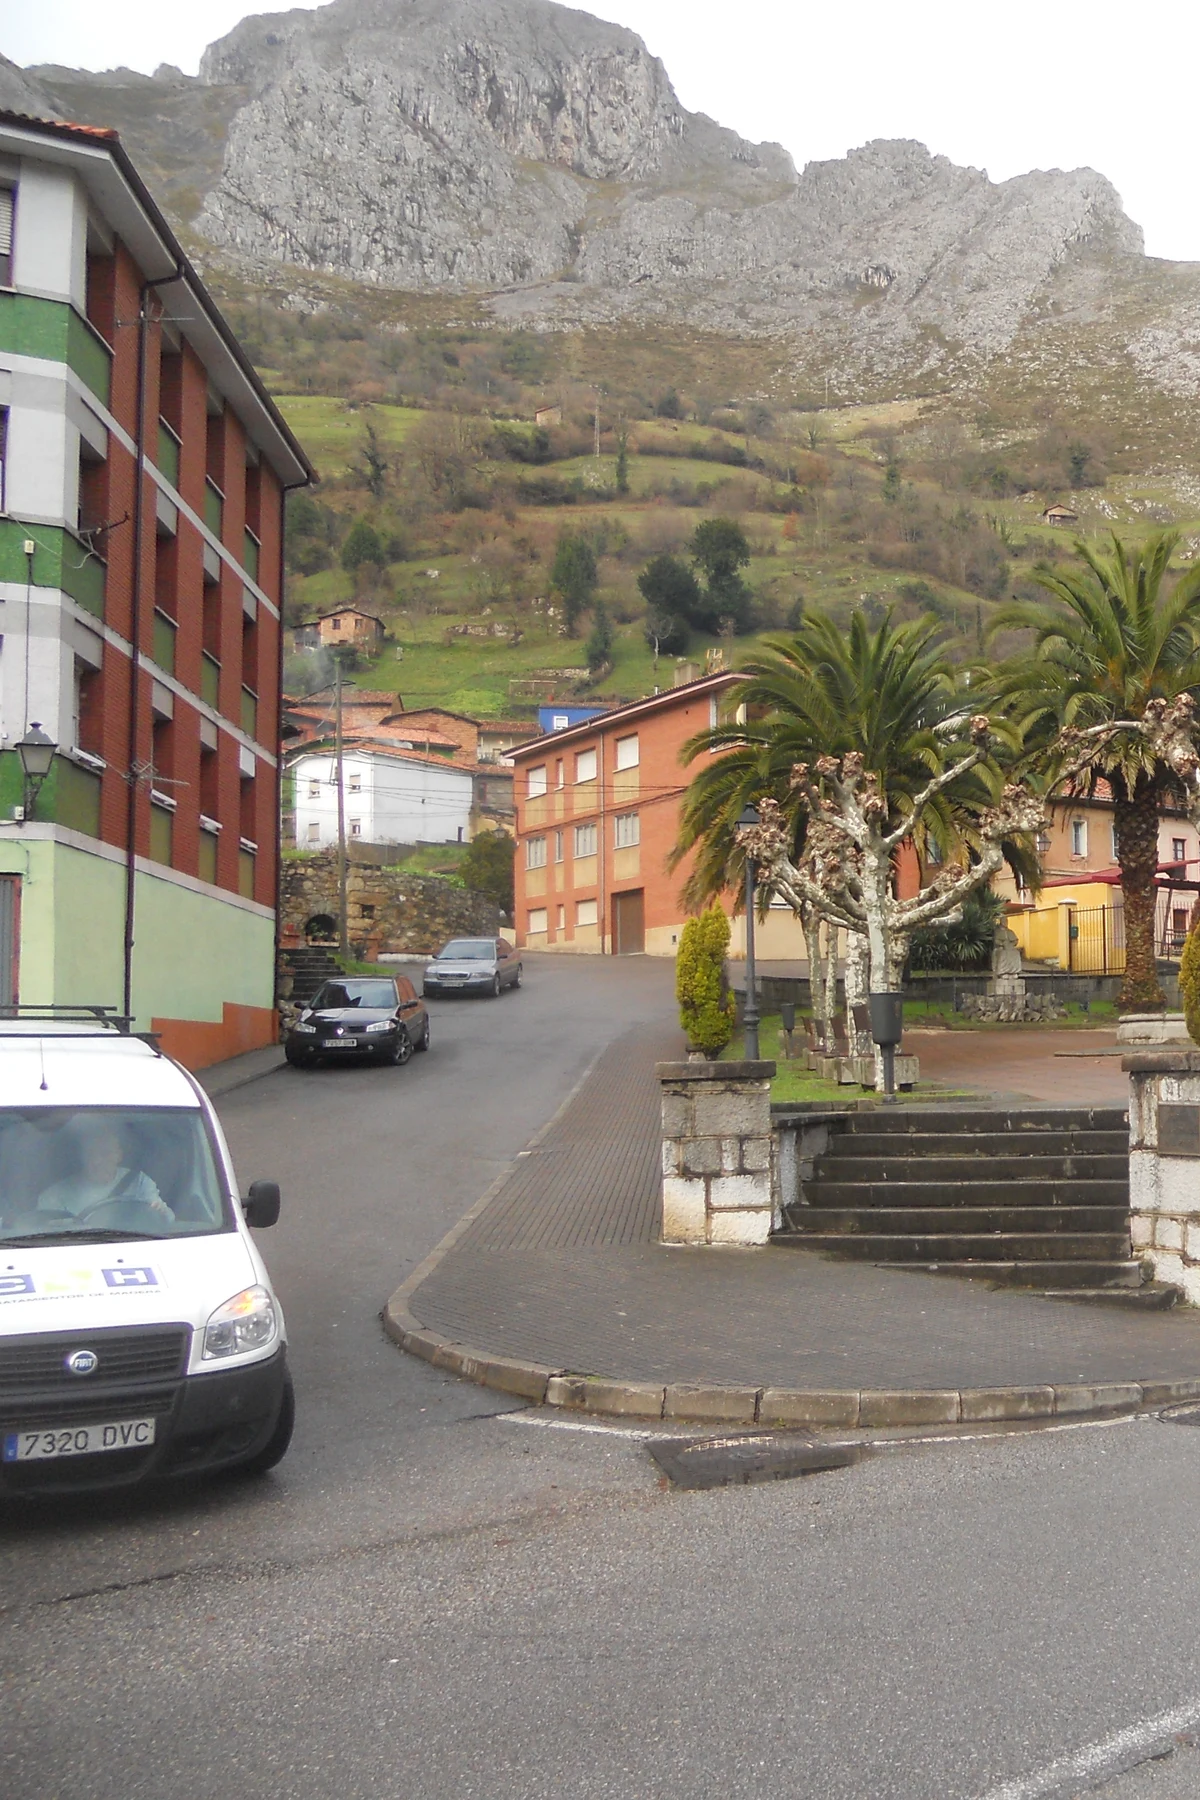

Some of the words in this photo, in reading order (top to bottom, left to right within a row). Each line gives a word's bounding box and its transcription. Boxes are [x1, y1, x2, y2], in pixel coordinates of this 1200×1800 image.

[0, 1294, 84, 1304] ATAMIENTOS
[74, 1359, 93, 1367] FIAT
[24, 1430, 89, 1456] 7320
[102, 1422, 149, 1447] DVC
